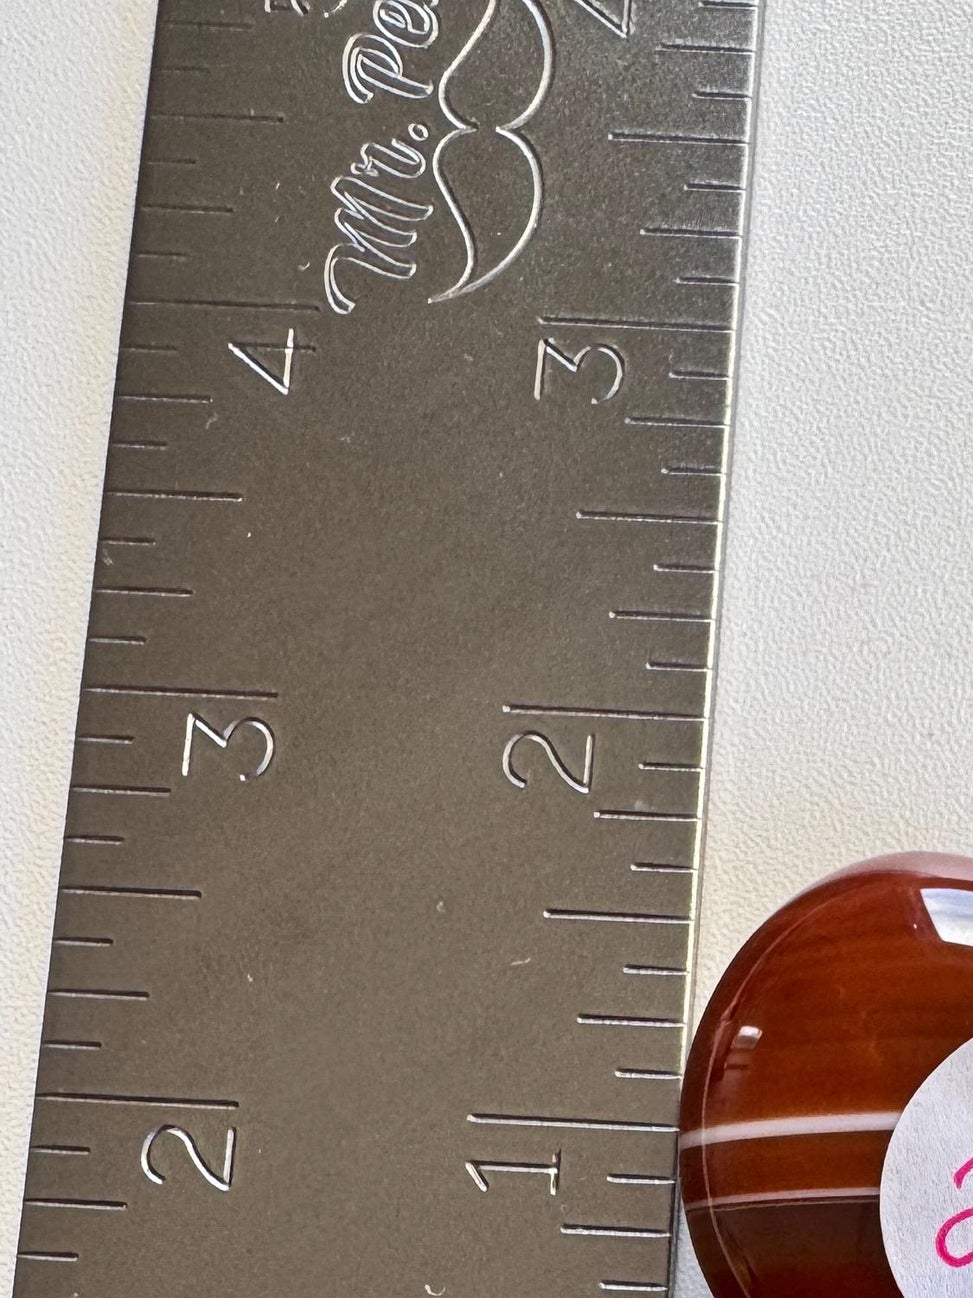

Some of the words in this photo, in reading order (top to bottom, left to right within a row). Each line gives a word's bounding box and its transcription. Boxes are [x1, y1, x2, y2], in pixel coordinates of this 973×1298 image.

[341, 0, 440, 104] Pe
[227, 327, 317, 396] 4
[532, 336, 626, 404] 3
[180, 712, 277, 782] 3
[501, 729, 597, 795] 2
[139, 1123, 237, 1193] 2
[464, 1148, 562, 1197] 1
